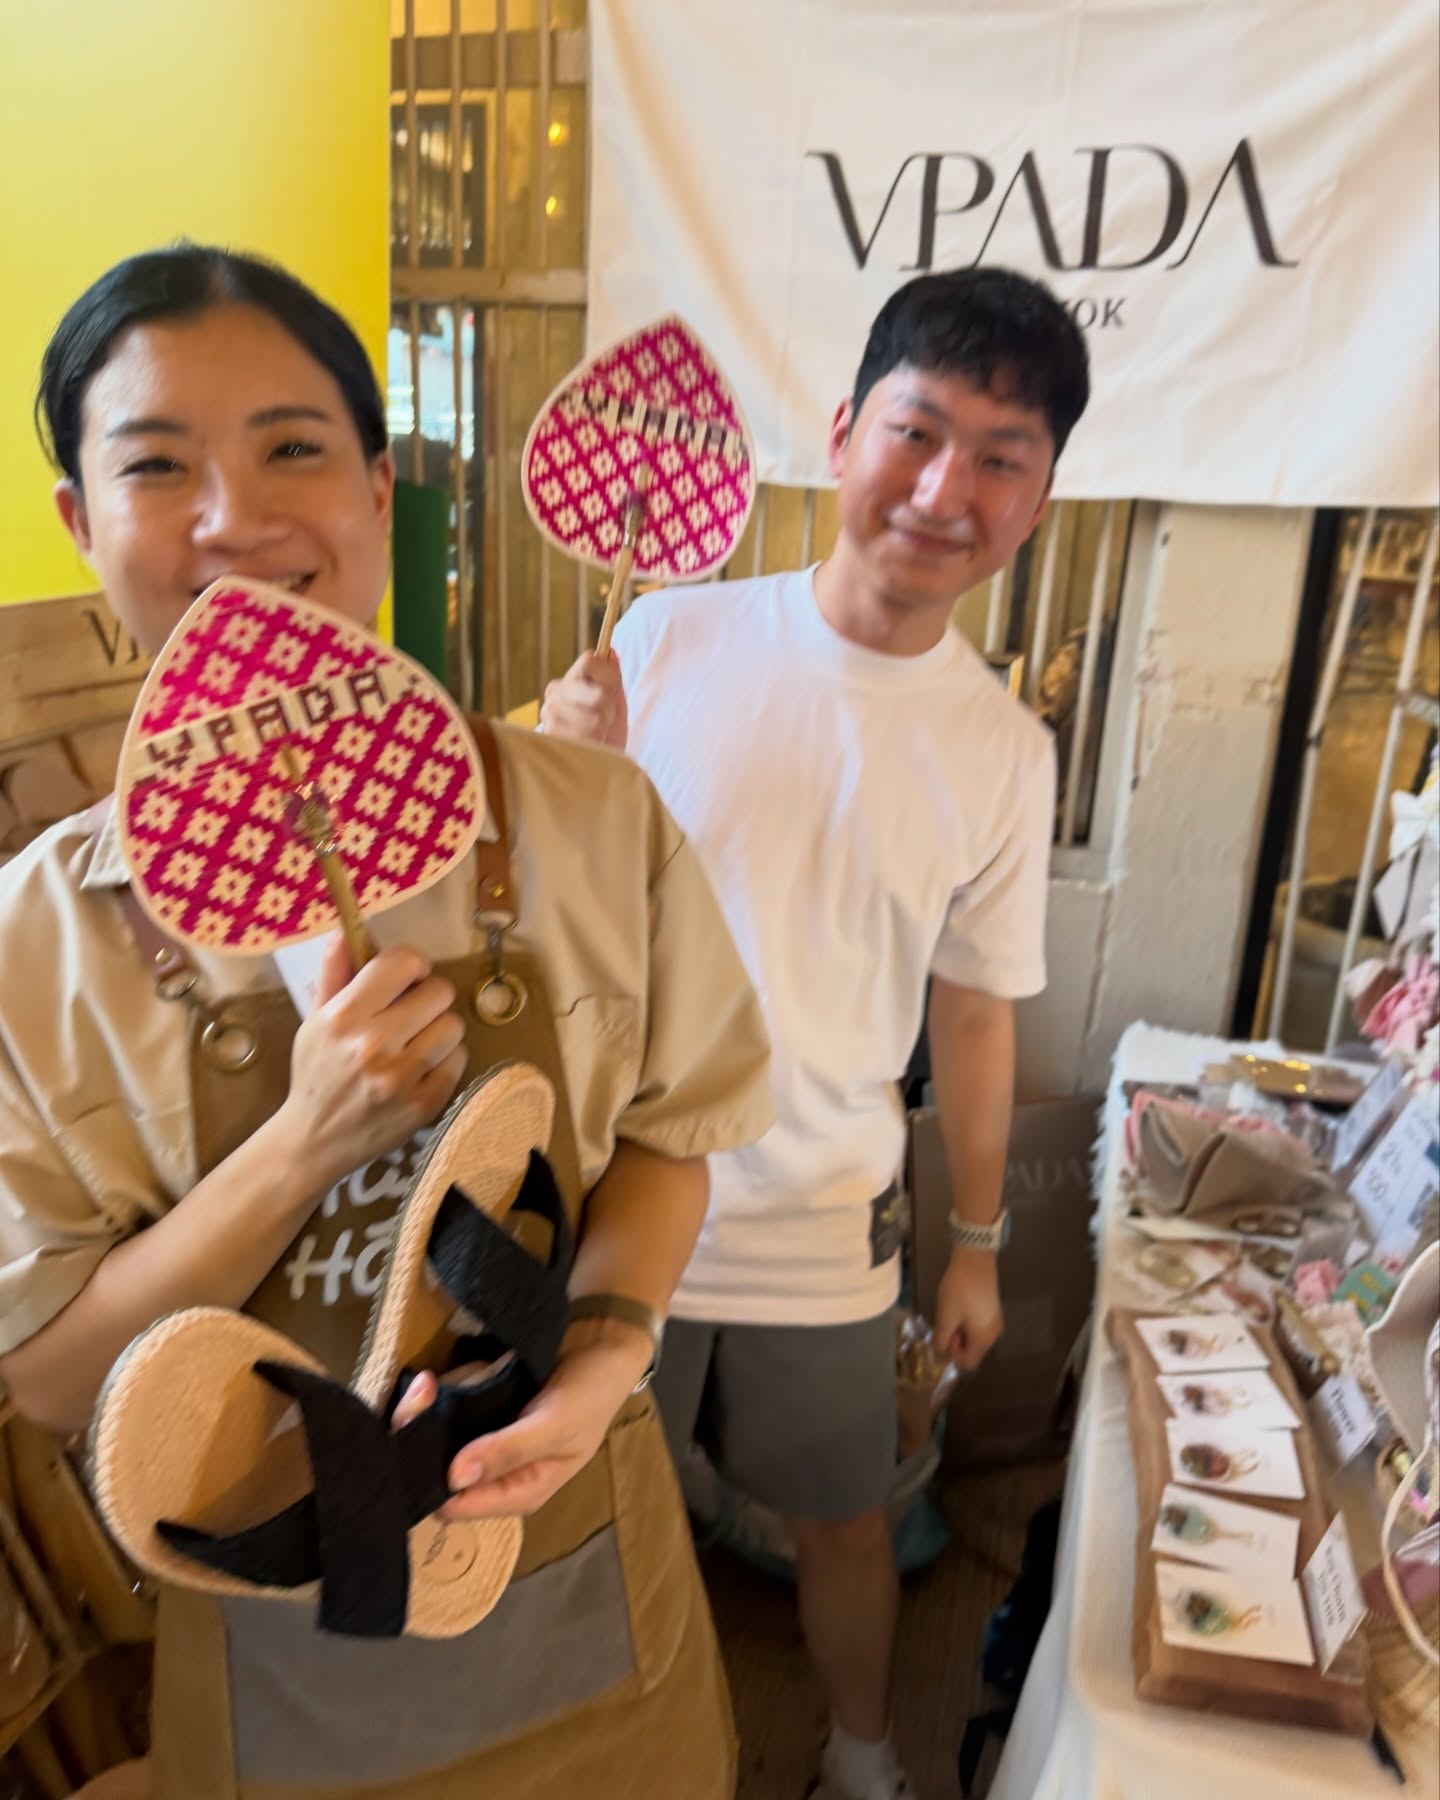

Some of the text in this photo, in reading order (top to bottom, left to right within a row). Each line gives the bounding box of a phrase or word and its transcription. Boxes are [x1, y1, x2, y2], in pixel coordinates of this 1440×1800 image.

[804, 137, 1300, 272] VPADA
[1063, 298, 1127, 328] OK
[145, 669, 387, 771] VPADA
